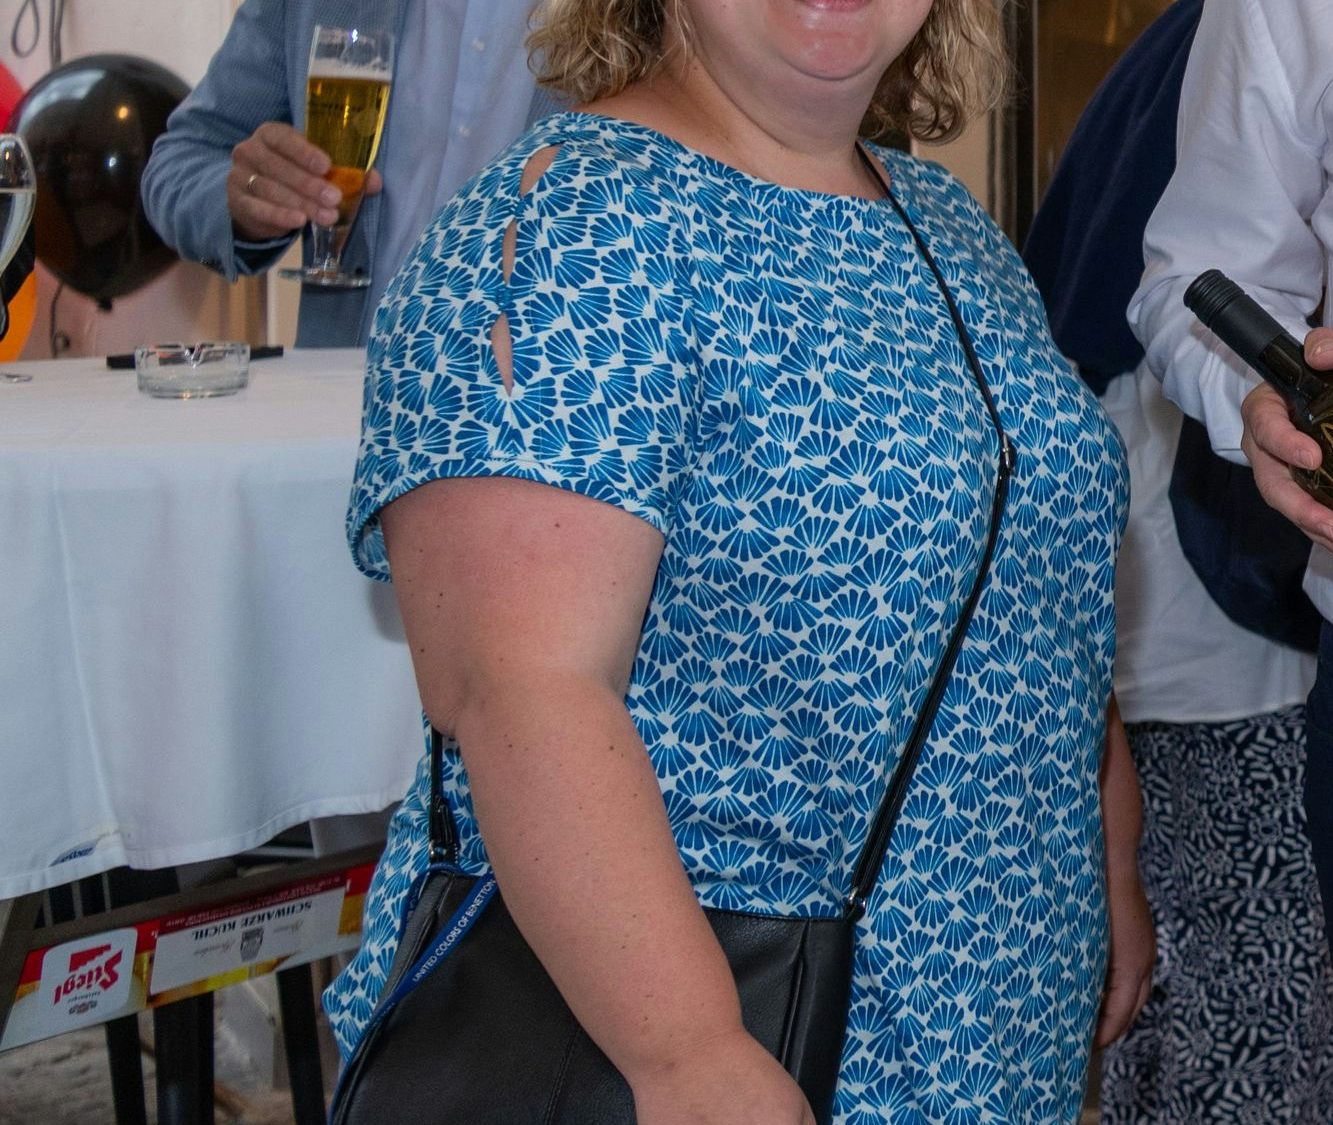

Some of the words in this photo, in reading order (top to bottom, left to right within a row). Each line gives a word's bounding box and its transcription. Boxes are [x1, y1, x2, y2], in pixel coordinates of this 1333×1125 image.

[53, 949, 123, 1005] Stiegl
[412, 955, 438, 982] UNITED
[435, 926, 462, 956] COLORS
[457, 915, 470, 928] OF
